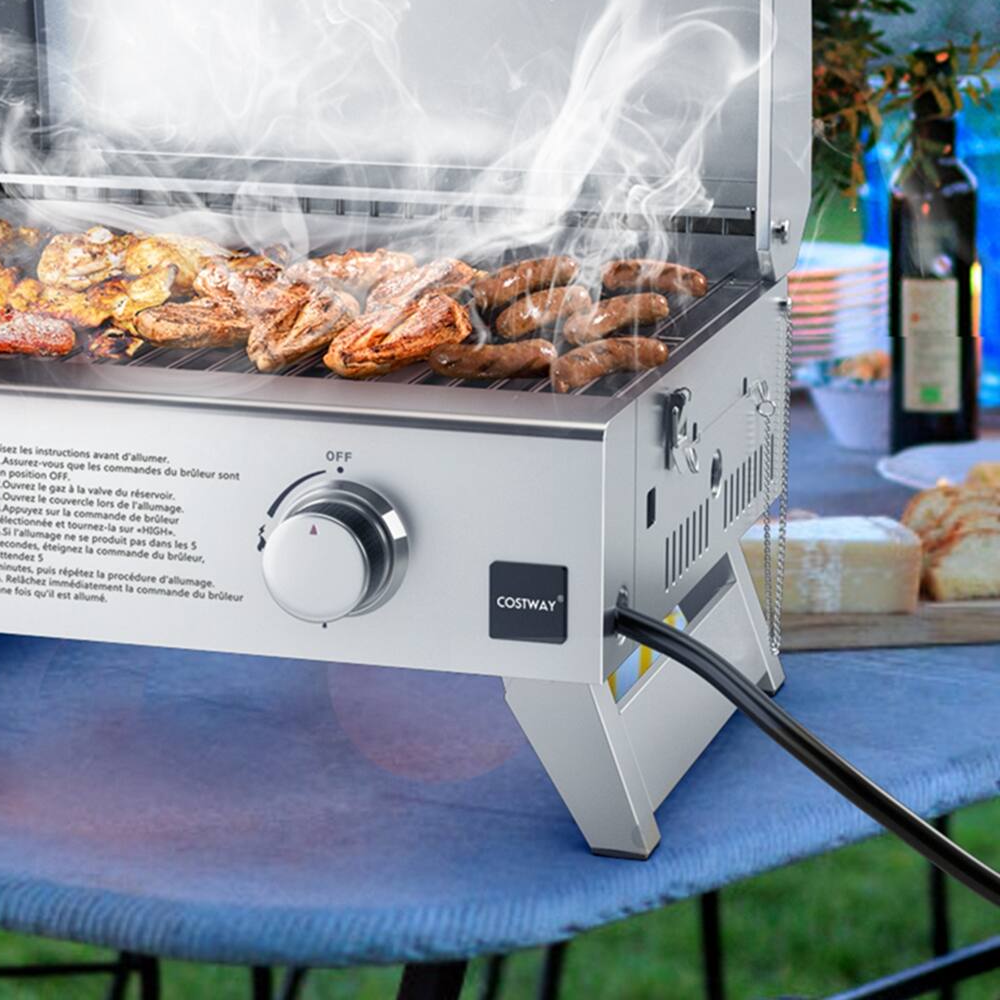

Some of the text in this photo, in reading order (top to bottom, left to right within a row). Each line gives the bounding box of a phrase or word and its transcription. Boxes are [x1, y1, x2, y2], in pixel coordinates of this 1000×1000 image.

[20, 446, 32, 455] les
[35, 447, 90, 458] instructions
[93, 452, 119, 460] avant
[122, 453, 169, 463] d'allumer.
[326, 450, 352, 462] OFF
[9, 470, 47, 479] position
[49, 471, 70, 481] OFF.
[67, 462, 85, 471] que
[88, 462, 101, 471] les
[104, 465, 161, 475] commandes
[164, 467, 177, 476] du
[38, 482, 47, 492] le
[49, 485, 66, 494] gaz
[77, 485, 85, 494] la
[88, 487, 112, 496] valve
[115, 488, 128, 497] du
[38, 494, 47, 503] le
[49, 497, 94, 507] couvercle
[97, 499, 114, 508] lors
[117, 500, 129, 509] de
[132, 501, 184, 515] l'allumage.
[63, 508, 71, 517] la
[74, 511, 126, 521] commande
[129, 513, 141, 522] de
[68, 521, 116, 532] tournez-la
[14, 528, 62, 542] l'allumage
[92, 535, 127, 545] produit
[130, 539, 146, 547] pas
[149, 539, 172, 548] dans
[175, 540, 188, 550] les
[191, 541, 197, 550] 5
[38, 554, 43, 562] 5
[85, 545, 93, 554] la
[96, 548, 149, 558] commande
[152, 551, 164, 560] du
[37, 566, 56, 575] puis
[97, 570, 105, 579] la
[159, 575, 214, 589] d'allumage.
[15, 587, 31, 596] fois
[34, 590, 54, 599] qu'il
[126, 584, 133, 593] la
[137, 587, 190, 598] commande
[192, 590, 205, 599] du
[497, 596, 556, 611] COSTWAY
